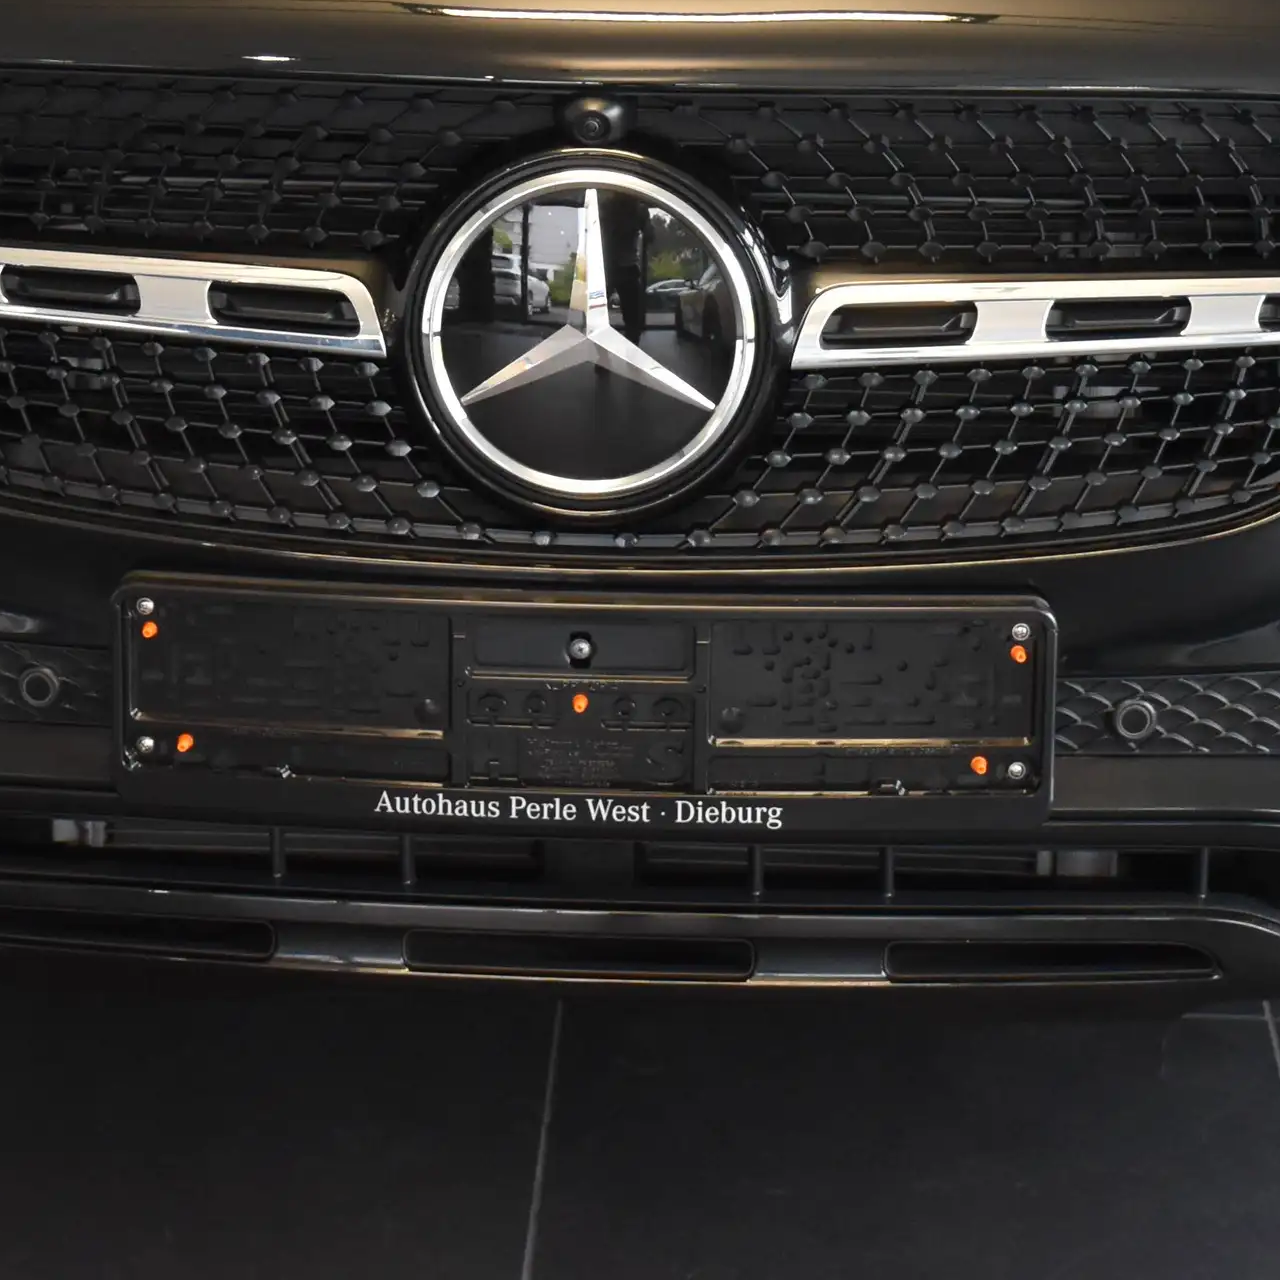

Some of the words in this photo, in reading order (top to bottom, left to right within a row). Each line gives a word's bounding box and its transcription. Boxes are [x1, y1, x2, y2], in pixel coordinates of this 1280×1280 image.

[374, 790, 501, 819] Autohaus
[509, 795, 577, 822] Perle
[585, 798, 651, 824] West
[675, 800, 783, 830] Dieburg
